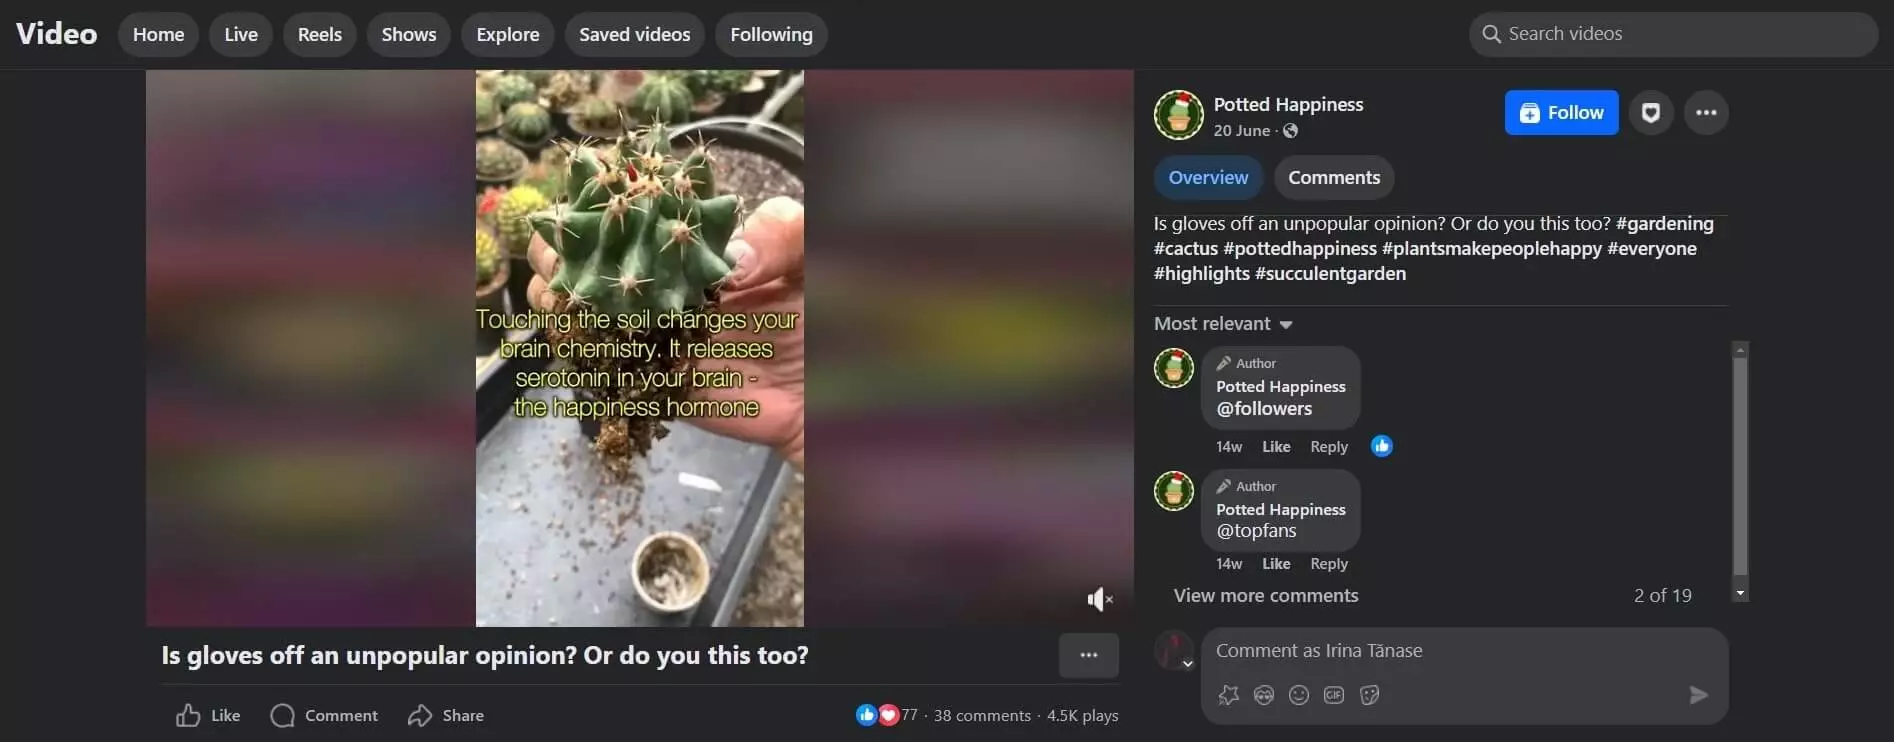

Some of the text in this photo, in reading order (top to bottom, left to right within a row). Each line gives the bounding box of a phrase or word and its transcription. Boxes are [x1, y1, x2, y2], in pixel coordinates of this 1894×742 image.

[15, 20, 98, 45] Video
[133, 27, 185, 42] Home
[224, 25, 259, 42] Live
[298, 26, 343, 42] Reels
[381, 26, 437, 42] Shows
[477, 26, 540, 46] Explore
[579, 25, 691, 42] Saved videos
[731, 25, 813, 46] Following
[1509, 25, 1623, 41] Search videos
[1214, 95, 1364, 116] Potted Happiness
[1548, 104, 1605, 120] Follow
[1213, 124, 1271, 137] 20 June
[1168, 168, 1249, 185] Overview
[1288, 170, 1381, 185] Comments
[1154, 215, 1714, 235] Is gloves off an unpopular opinion? Or do you this too? #gardening
[1153, 239, 1698, 260] #cactus #pottedhappiness #plantsmakepeoplehappy #everyone
[1153, 264, 1407, 285] #highlights #succulentgarden
[1154, 315, 1272, 331] Most relevant
[1236, 357, 1277, 369] Author
[1216, 379, 1347, 397] Potted Happiness
[1216, 400, 1313, 418] @followers
[1216, 440, 1243, 453] 14w
[1262, 440, 1292, 453] Like
[1311, 440, 1349, 456] Reply
[1236, 480, 1278, 493] Author
[1216, 502, 1347, 520] Potted Happiness
[1217, 522, 1297, 542] @topfans
[1216, 557, 1243, 570] 14w
[1262, 557, 1292, 570] Like
[1311, 557, 1349, 573] Reply
[1173, 586, 1360, 603] View more comments
[1634, 587, 1692, 603] 2 of 19
[162, 644, 809, 671] Is gloves off an unpopular opinion? Or do you this too?
[1216, 642, 1423, 658] Comment as Irina Tănase
[1326, 691, 1342, 700] GIF
[211, 708, 241, 722] Like
[305, 709, 379, 722] Comment
[443, 708, 485, 722] Share
[901, 708, 918, 721] 77
[934, 709, 1032, 722] 38 comments
[1047, 708, 1119, 726] 4.5K plays
